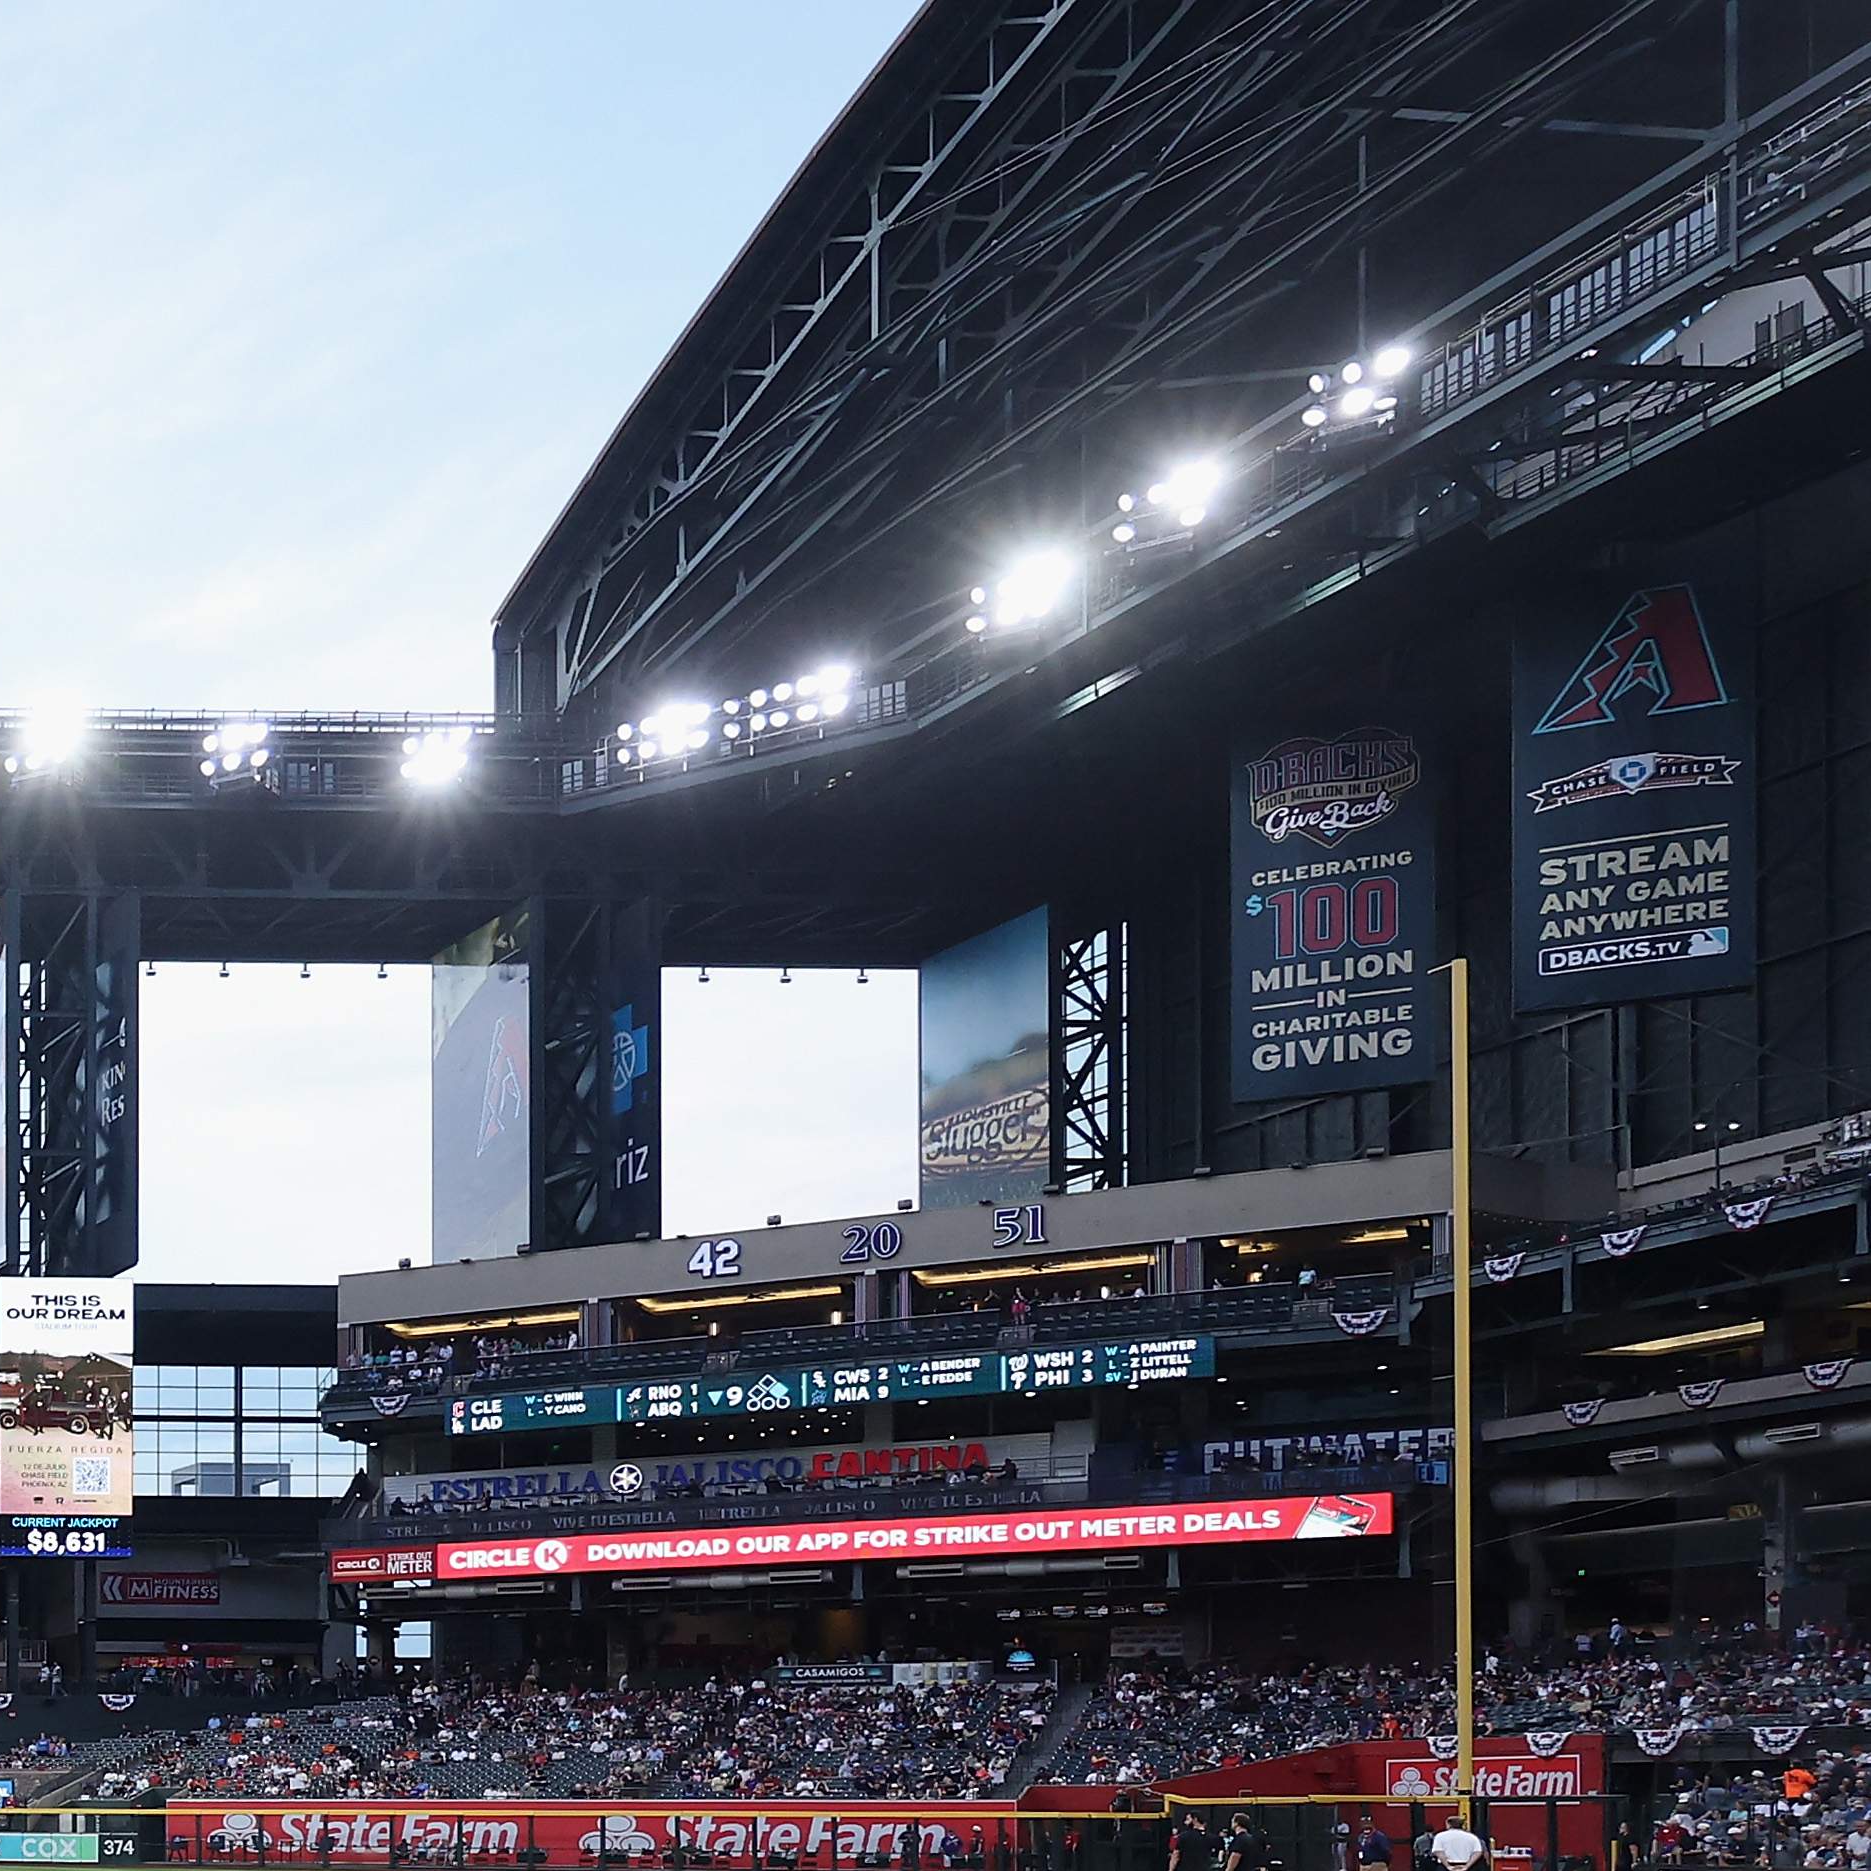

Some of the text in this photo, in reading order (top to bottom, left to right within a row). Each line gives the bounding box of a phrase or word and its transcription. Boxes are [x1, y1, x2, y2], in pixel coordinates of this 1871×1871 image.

[1551, 763, 1715, 795] CHASE FIELD
[1265, 807, 1324, 840] Give
[1251, 851, 1413, 887] CELEBRATING
[1539, 835, 1729, 886] STREAM
[1539, 869, 1730, 915] ANY GAME
[1539, 898, 1729, 941] ANYWHERE
[1549, 941, 1682, 969] DBACKS.TV
[1252, 950, 1413, 993] MILLION
[1316, 990, 1346, 1008] IN
[1252, 1005, 1413, 1039] CHARITABLE
[1252, 1028, 1413, 1072] GIVING
[688, 1205, 1049, 1277] 42 20 51
[31, 1295, 100, 1306] THIS IS
[7, 1309, 125, 1320] OUR DREAM
[1034, 1340, 1197, 1369] WSH PAINTER
[834, 1358, 981, 1385] CWS BENDER
[1035, 1367, 1188, 1386] PHI DURAN
[648, 1384, 682, 1400] RNO
[726, 1387, 743, 1406] 9
[834, 1372, 972, 1402] MIA FEDDE
[471, 1400, 502, 1415] CLE
[648, 1401, 681, 1417] ABQ
[471, 1416, 502, 1431] LAD
[430, 1444, 989, 1501] ESTRELLA CANTINA
[12, 1517, 119, 1528] CURRENT JACKPOT
[27, 1529, 106, 1554] $8,631
[587, 1509, 1281, 1563] DOWNLOAD OUR APP FOR STRIKE OUT METER DEALS
[337, 1559, 367, 1570] CIRCLE
[387, 1551, 433, 1564] STRIKE OUT
[387, 1559, 433, 1575] METER
[449, 1548, 530, 1569] CIRCLE
[154, 1585, 218, 1600] FITNESS
[22, 1838, 77, 1857] COX
[104, 1840, 134, 1855] 374
